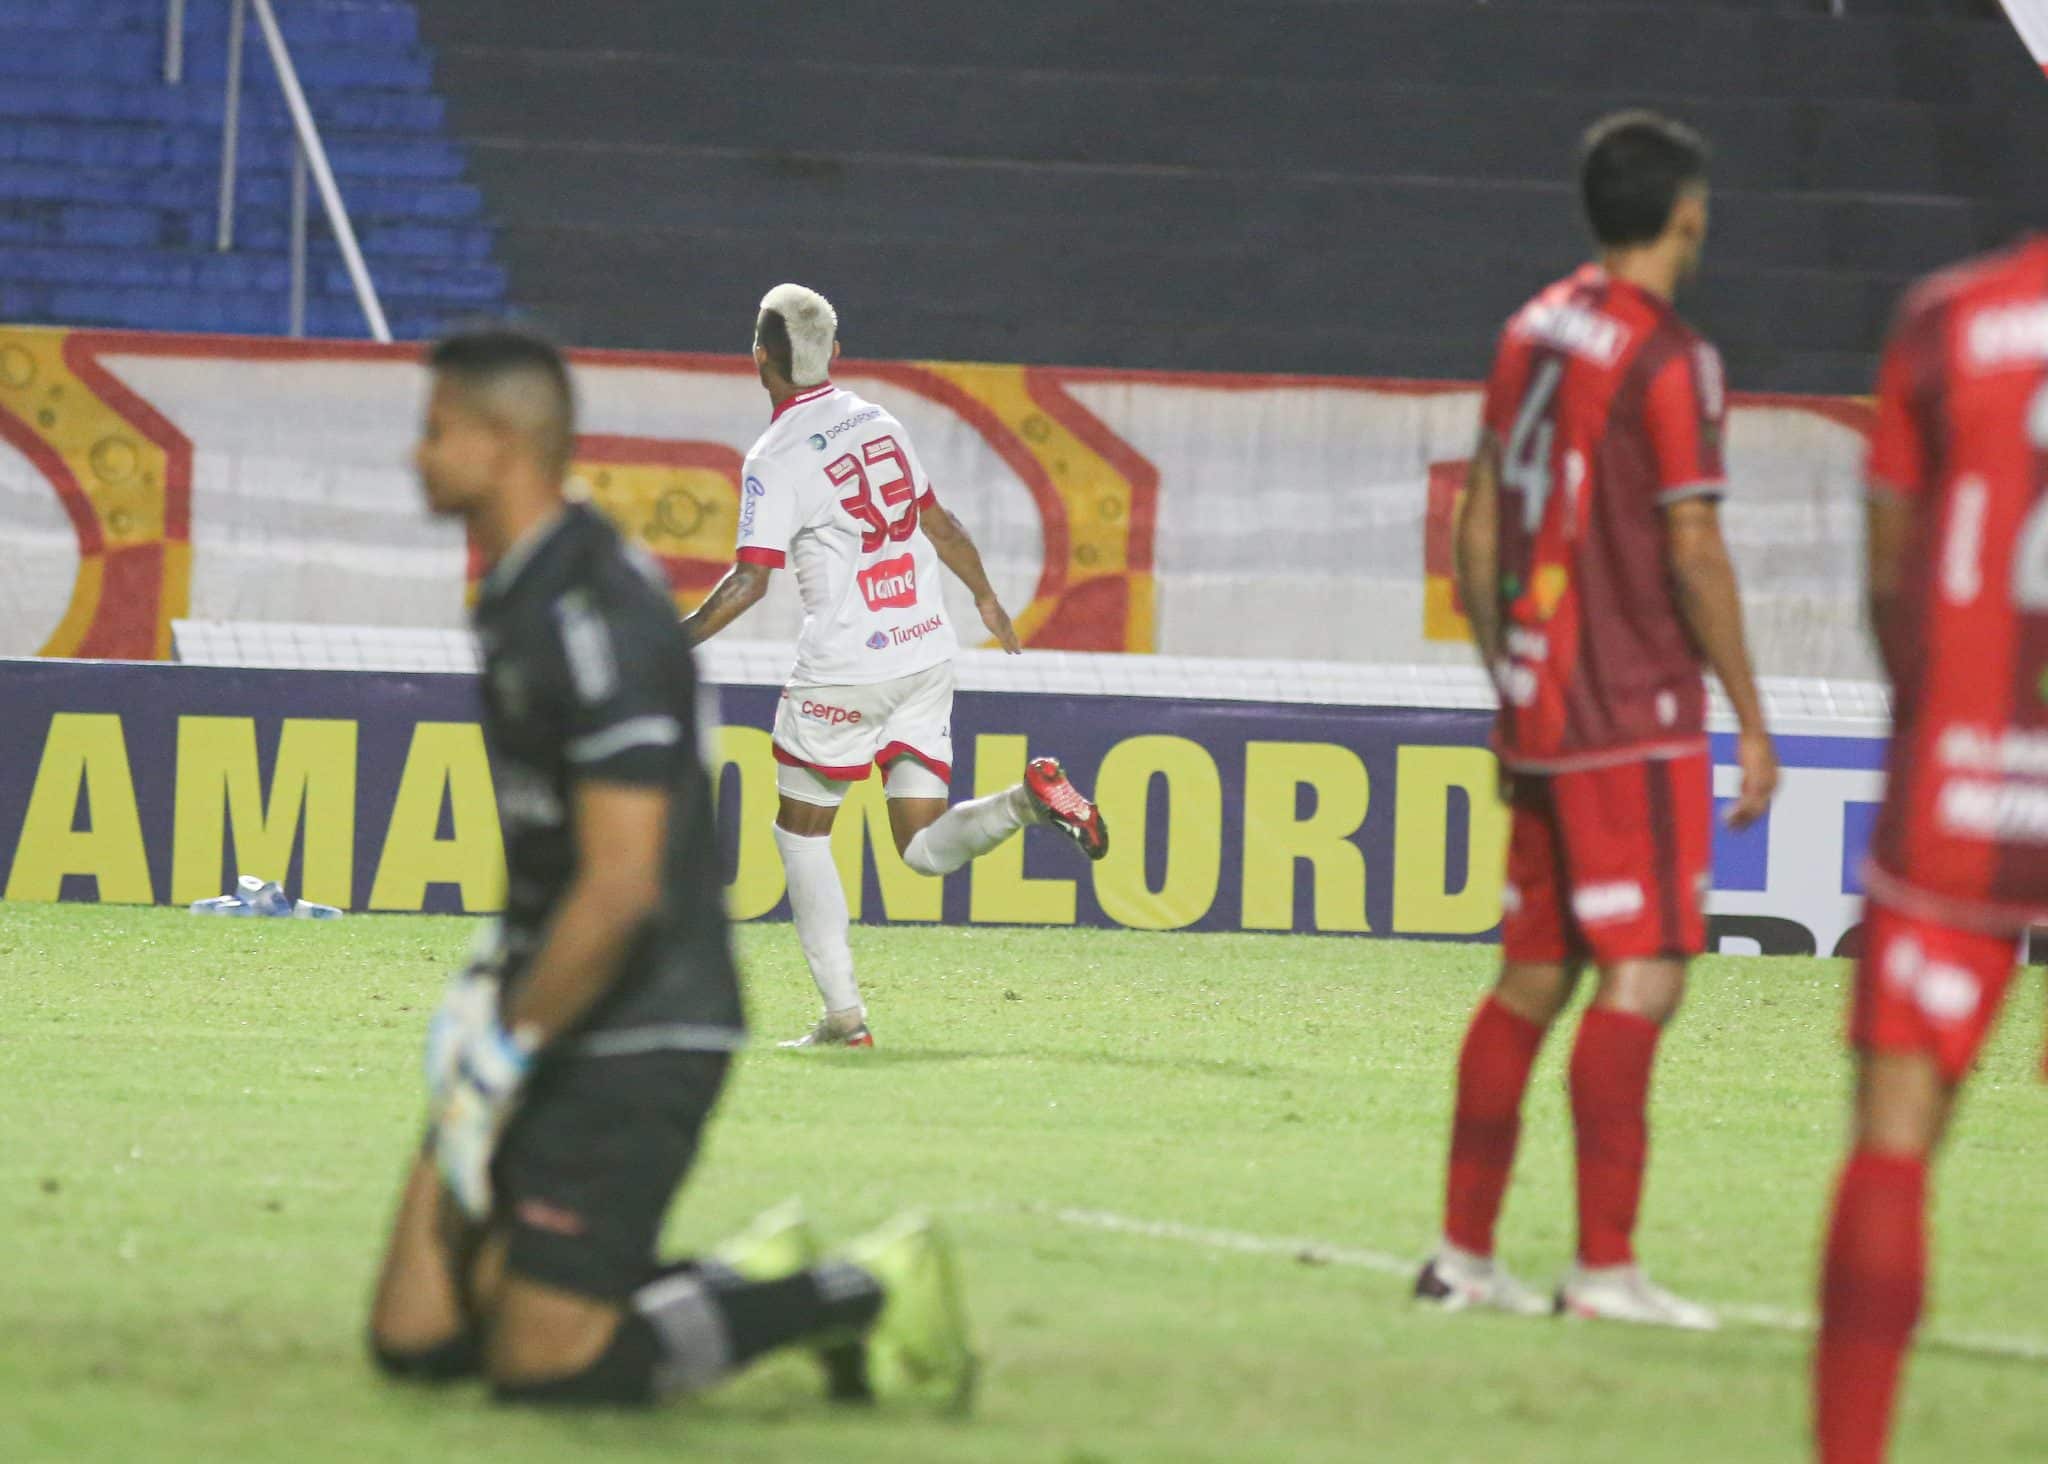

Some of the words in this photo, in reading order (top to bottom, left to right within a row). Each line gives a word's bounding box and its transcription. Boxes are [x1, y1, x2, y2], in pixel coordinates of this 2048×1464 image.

[824, 435, 916, 554] 33
[1503, 358, 1563, 534] 4
[802, 700, 863, 726] cerpe
[5, 711, 1510, 936] AMAONLORD
